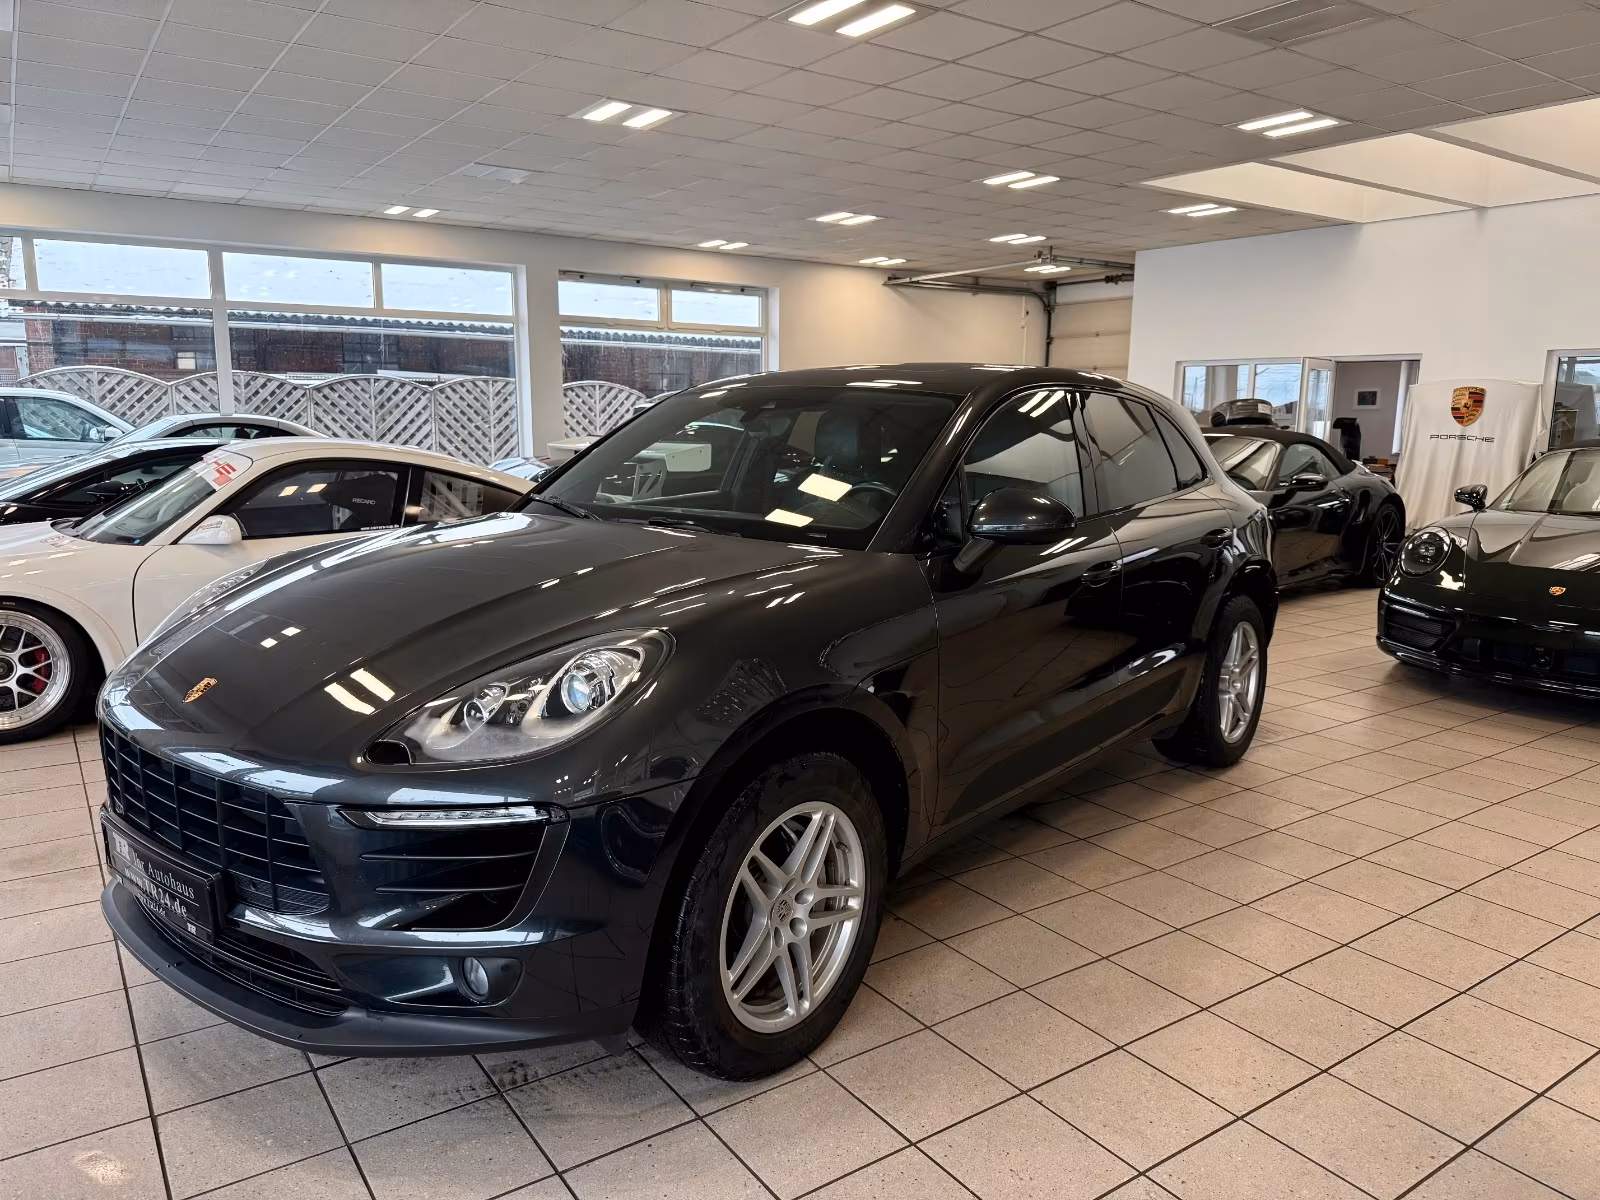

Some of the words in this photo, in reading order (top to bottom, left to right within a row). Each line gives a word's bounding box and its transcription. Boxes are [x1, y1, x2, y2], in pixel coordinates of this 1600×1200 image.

[1429, 434, 1496, 443] PORSCHE
[352, 497, 376, 505] RECARO
[132, 851, 145, 871] Ihr
[148, 862, 195, 899] Autohaus
[124, 867, 188, 917] www.TR24.de
